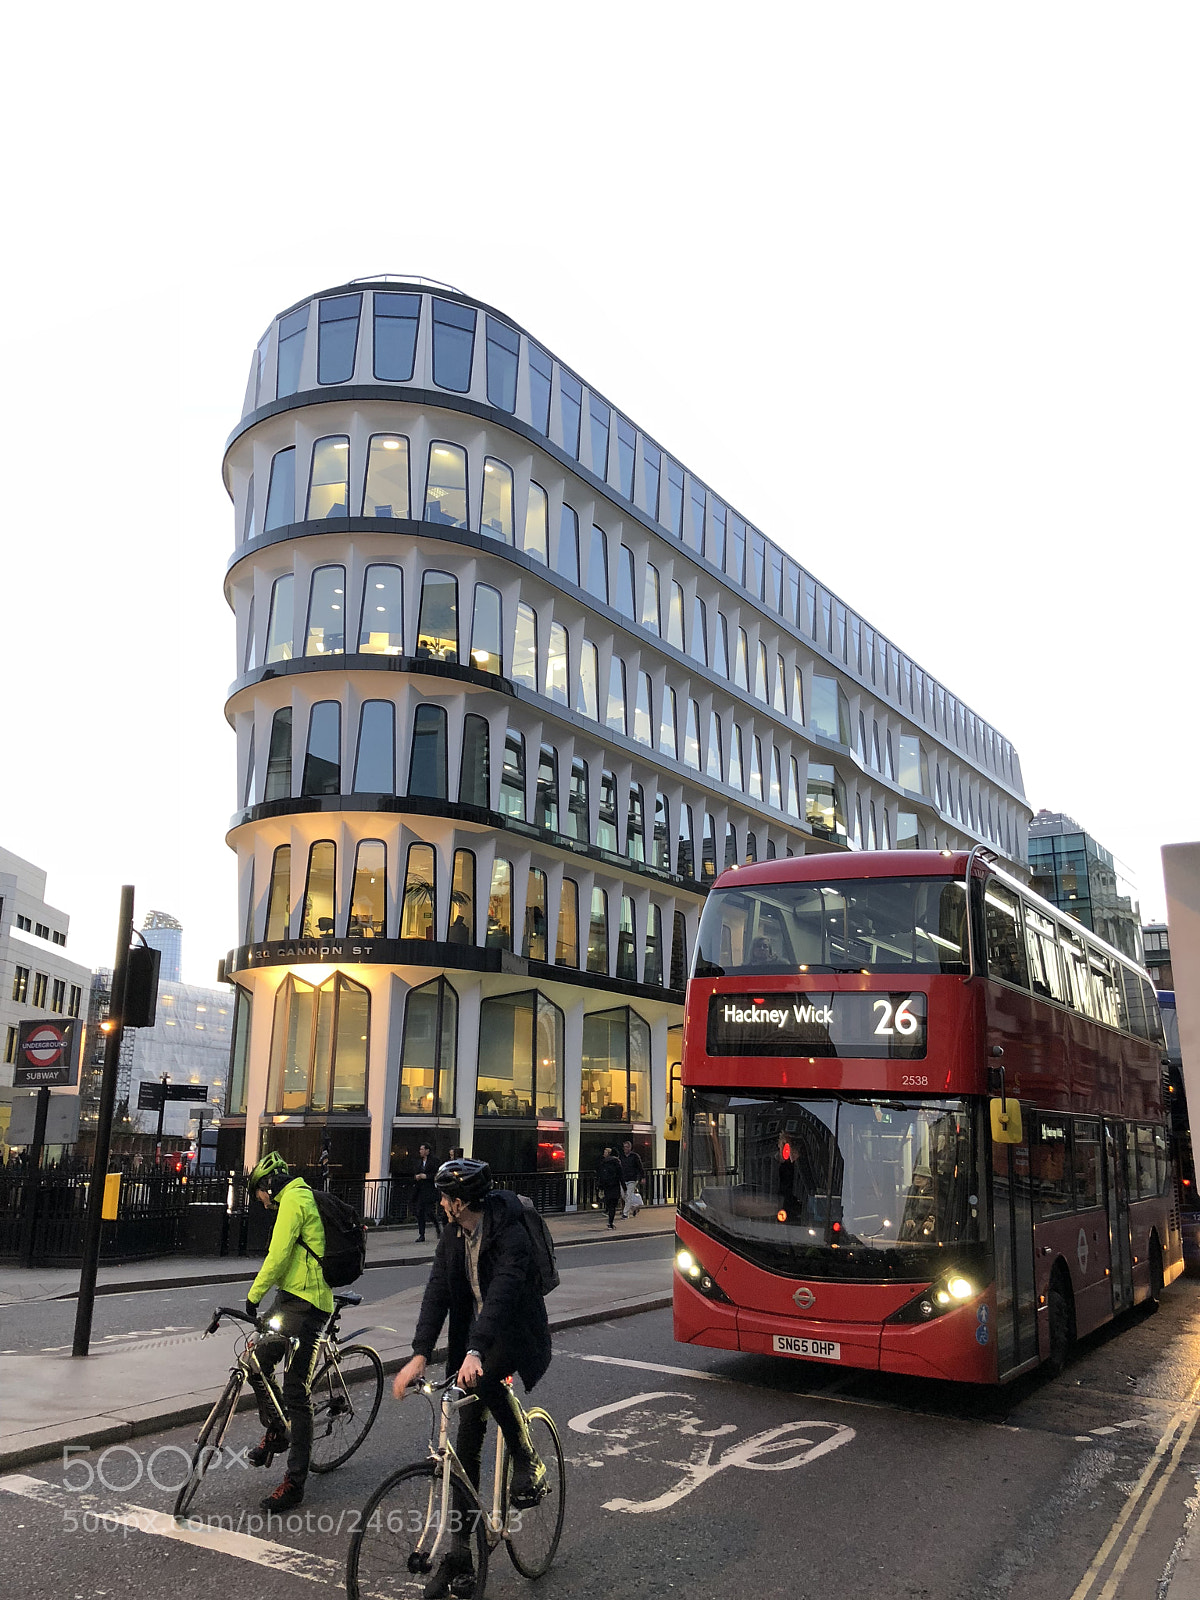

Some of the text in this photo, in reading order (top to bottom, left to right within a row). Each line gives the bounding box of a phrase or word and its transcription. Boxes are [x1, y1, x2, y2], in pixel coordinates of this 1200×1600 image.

[277, 946, 343, 957] CANNON
[352, 946, 373, 955] ST
[724, 1004, 834, 1028] Hackney Wick
[873, 999, 918, 1035] 26
[22, 1041, 68, 1049] UNDERGROUND
[26, 1071, 59, 1080] SUBWAY
[902, 1075, 929, 1086] 2538
[777, 1337, 835, 1356] SN65 OHP
